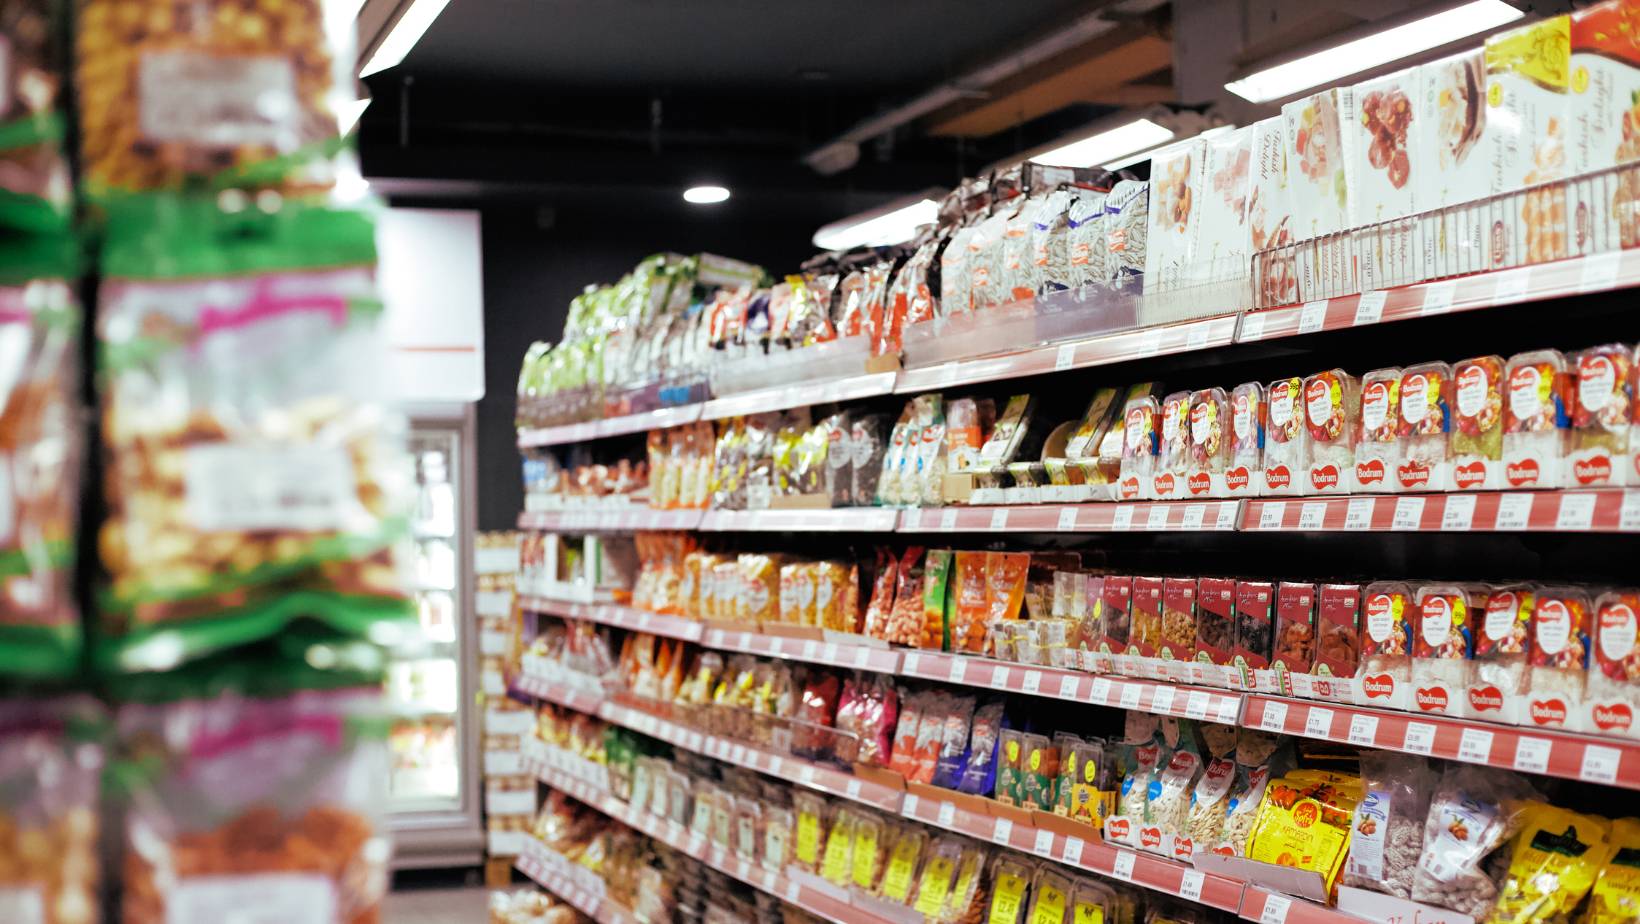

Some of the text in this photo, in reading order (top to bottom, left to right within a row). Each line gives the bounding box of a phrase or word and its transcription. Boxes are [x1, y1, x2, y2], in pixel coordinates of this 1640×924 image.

[1261, 134, 1271, 180] Delight
[1271, 129, 1282, 176] Turkish
[1358, 468, 1384, 479] Bodrum
[1457, 468, 1485, 480] Bodrum
[1508, 467, 1538, 478] Bodrum
[1577, 464, 1611, 477] Bodrum
[1227, 475, 1248, 484] Bodrum
[1266, 471, 1290, 483] Bodrum
[1313, 474, 1337, 485] Bodrum
[1189, 479, 1210, 489] Bodrum
[1366, 681, 1392, 692] Bodrum
[1418, 694, 1447, 705] Bodrum
[1472, 694, 1501, 705] Bodrum
[1533, 707, 1565, 720] Bodrum
[1597, 712, 1631, 724] Bodrum
